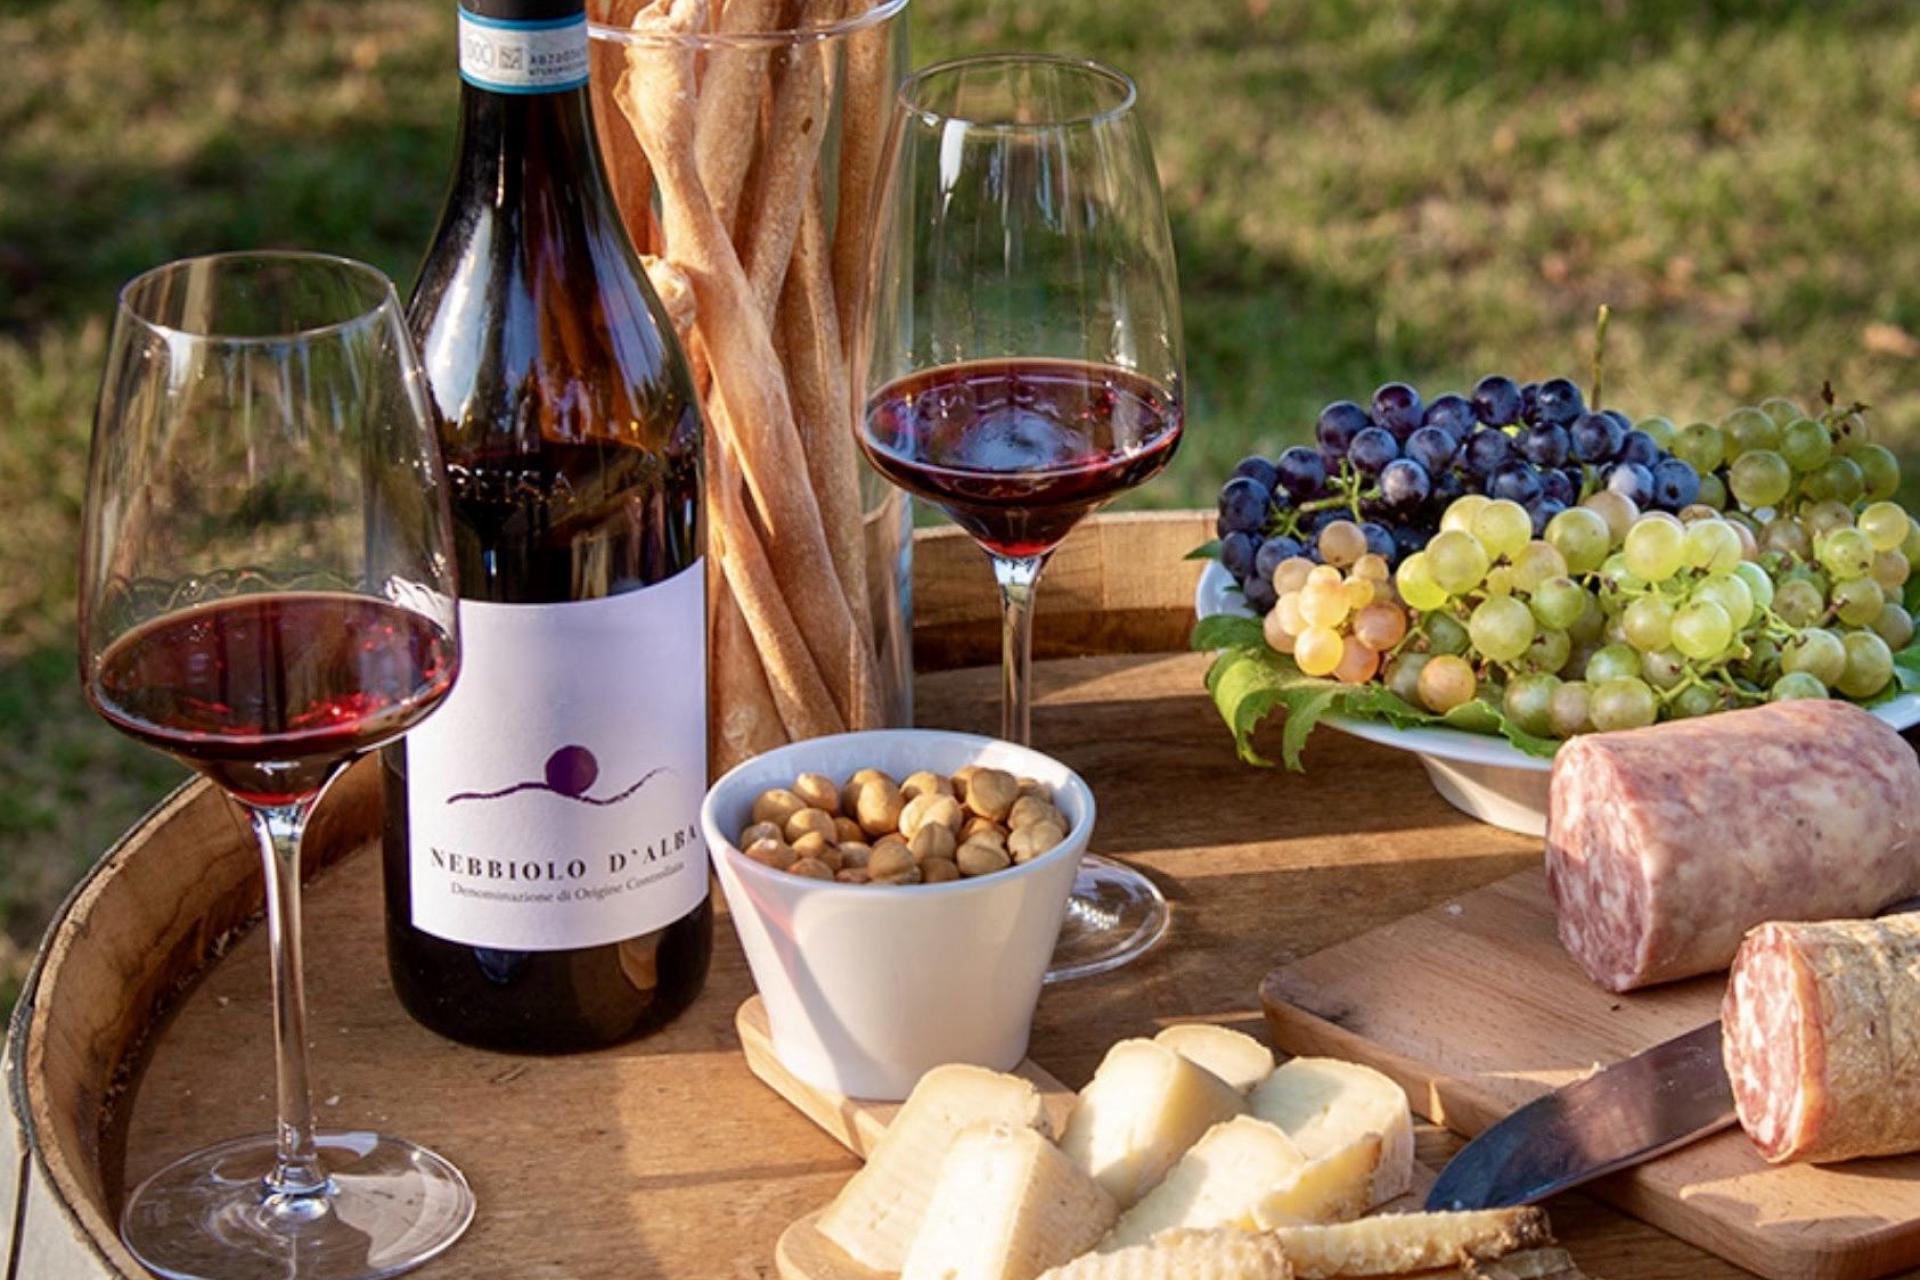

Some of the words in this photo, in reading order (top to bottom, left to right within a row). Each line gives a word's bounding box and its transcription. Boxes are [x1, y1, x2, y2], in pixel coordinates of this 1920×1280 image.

[430, 847, 586, 881] NEBBIOLO
[451, 882, 553, 903] Denominazione
[556, 888, 572, 903] di
[574, 884, 622, 902] Origine
